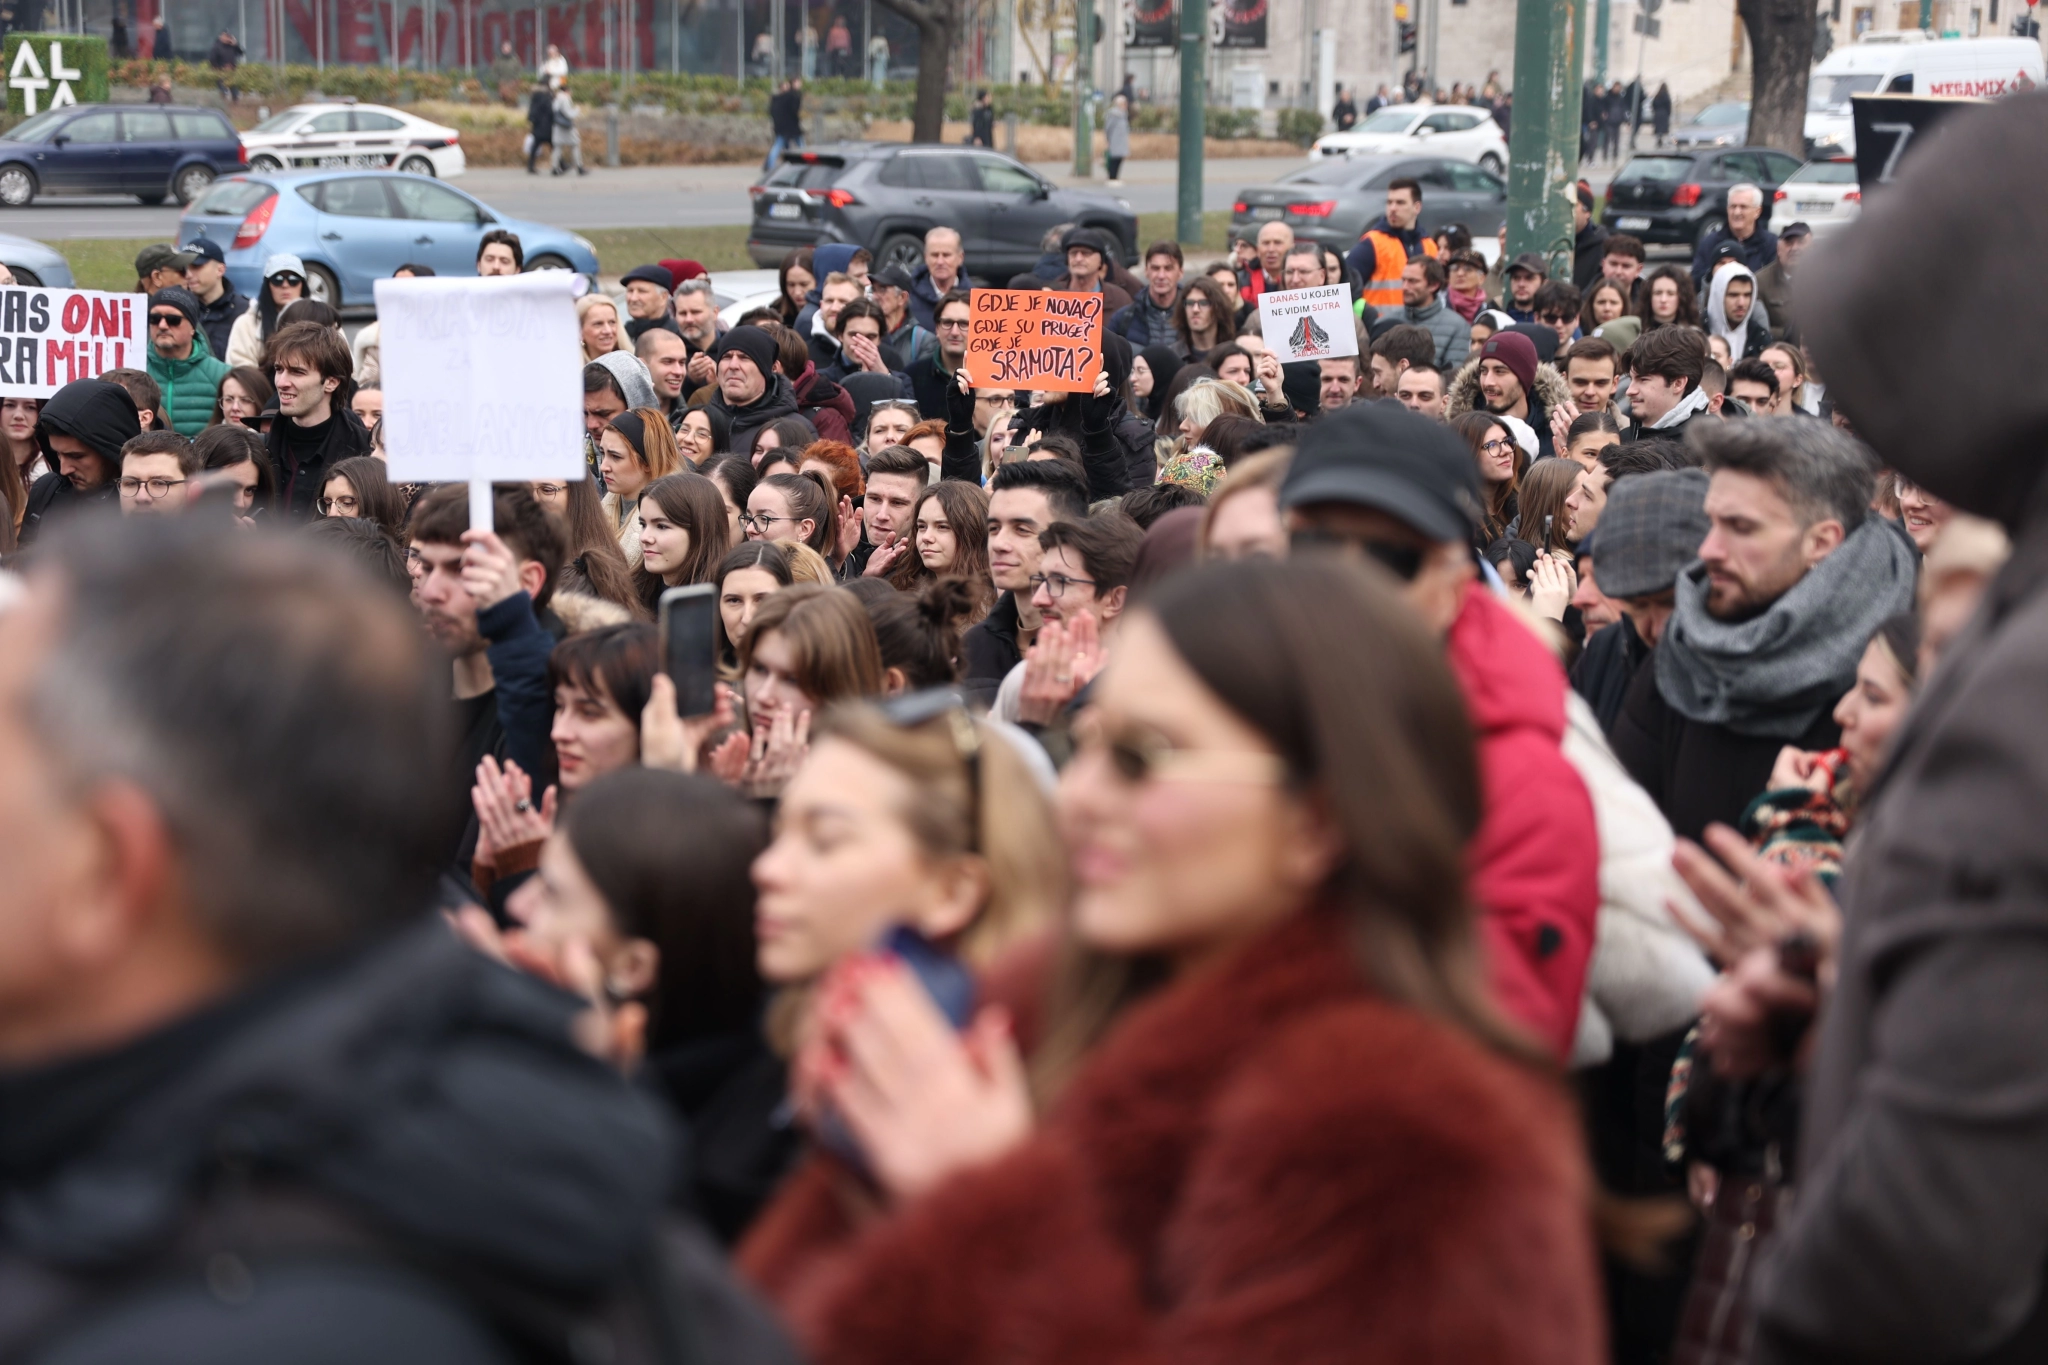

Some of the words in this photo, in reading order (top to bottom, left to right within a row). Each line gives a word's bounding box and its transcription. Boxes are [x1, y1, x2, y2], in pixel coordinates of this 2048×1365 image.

[9, 39, 81, 80] AL
[1930, 79, 2007, 96] MEGAMIX
[977, 293, 1021, 312] GDJE
[1024, 295, 1042, 312] JE
[1269, 293, 1300, 304] DANAS
[1301, 292, 1308, 300] U
[1309, 288, 1340, 299] KOJEM
[0, 290, 50, 333] AS
[1271, 308, 1284, 316] NE
[1284, 305, 1310, 315] VIDIM
[1311, 301, 1341, 312] SUTRA
[973, 318, 1008, 334] GDJE
[1014, 319, 1035, 334] SU
[1041, 319, 1090, 342] PRUGE?
[970, 336, 1002, 352] GDJE
[1006, 334, 1022, 349] JE
[990, 346, 1094, 382] SRAMOTA?
